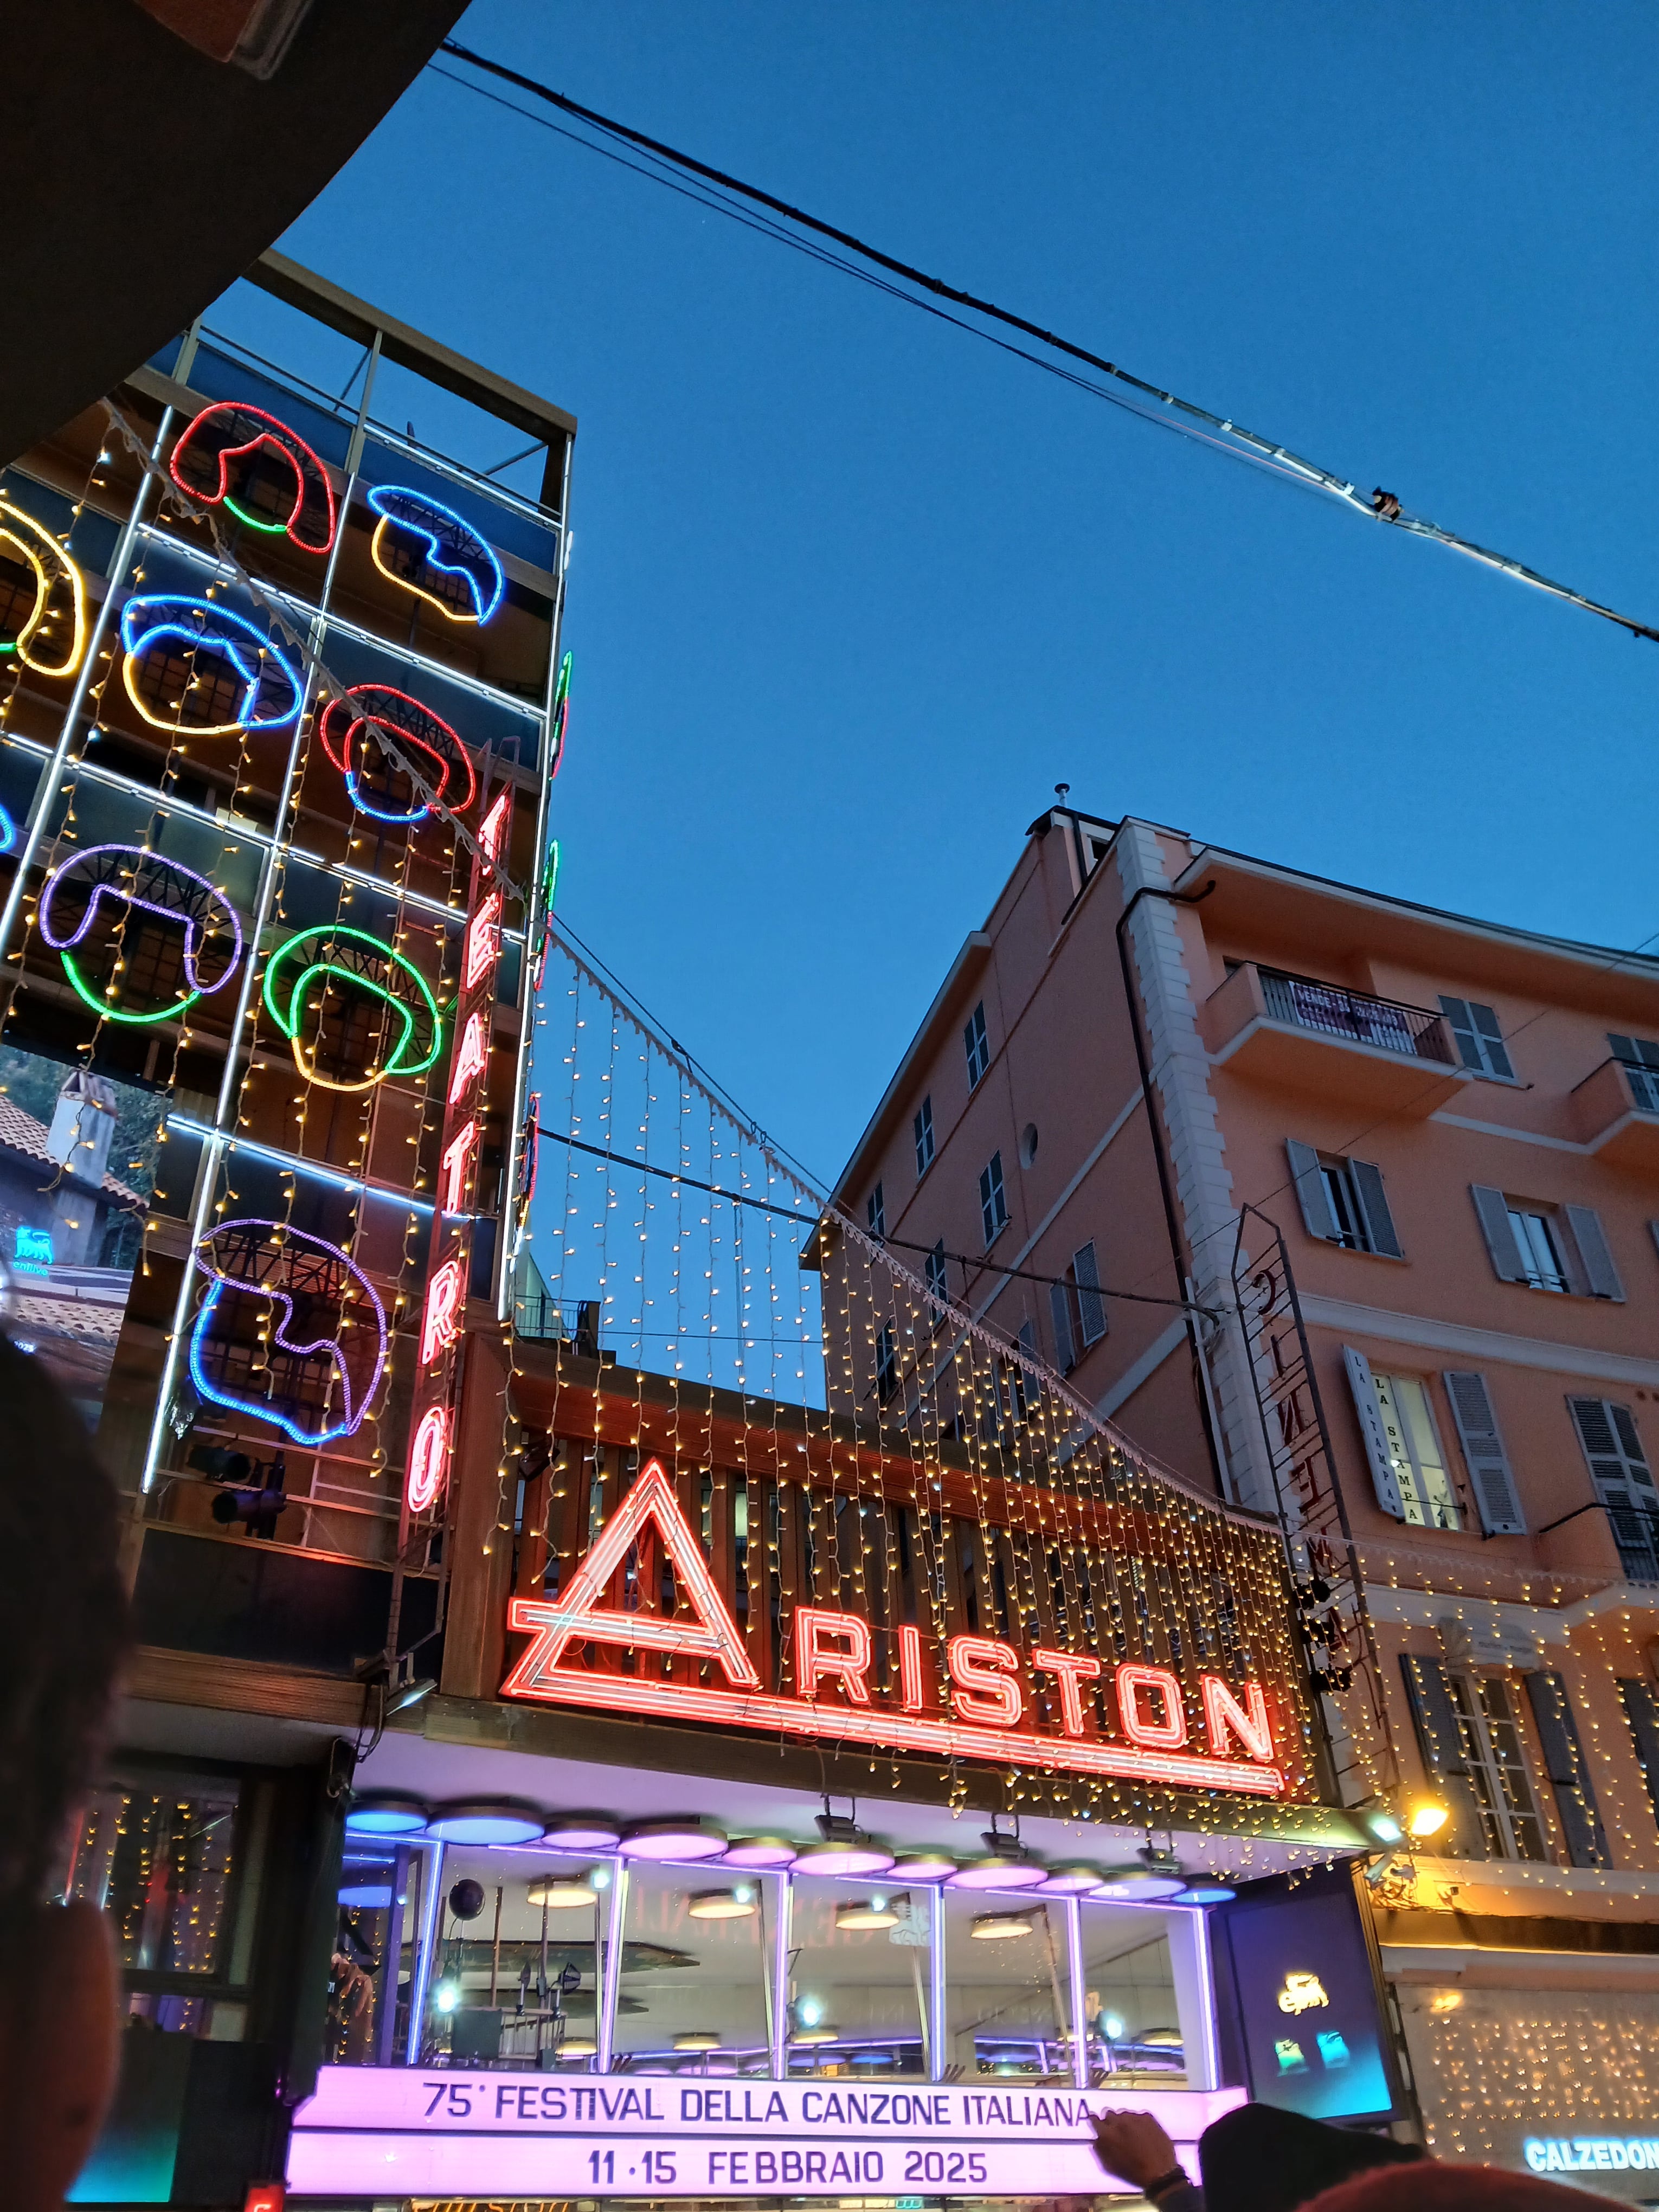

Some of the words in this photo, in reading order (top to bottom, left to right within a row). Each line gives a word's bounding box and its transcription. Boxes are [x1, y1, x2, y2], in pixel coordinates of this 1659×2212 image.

[407, 793, 507, 1514] TEATRO
[1374, 1378, 1395, 1405] LA
[1387, 1426, 1418, 1520] STAMPA
[496, 2085, 664, 2121] FESTIVAL
[681, 2089, 788, 2123] DELLA
[802, 2092, 951, 2125] CANZONE
[963, 2095, 1093, 2127] ITALIANA
[709, 2151, 883, 2184] FEBBRAIO
[905, 2151, 987, 2183] 2025
